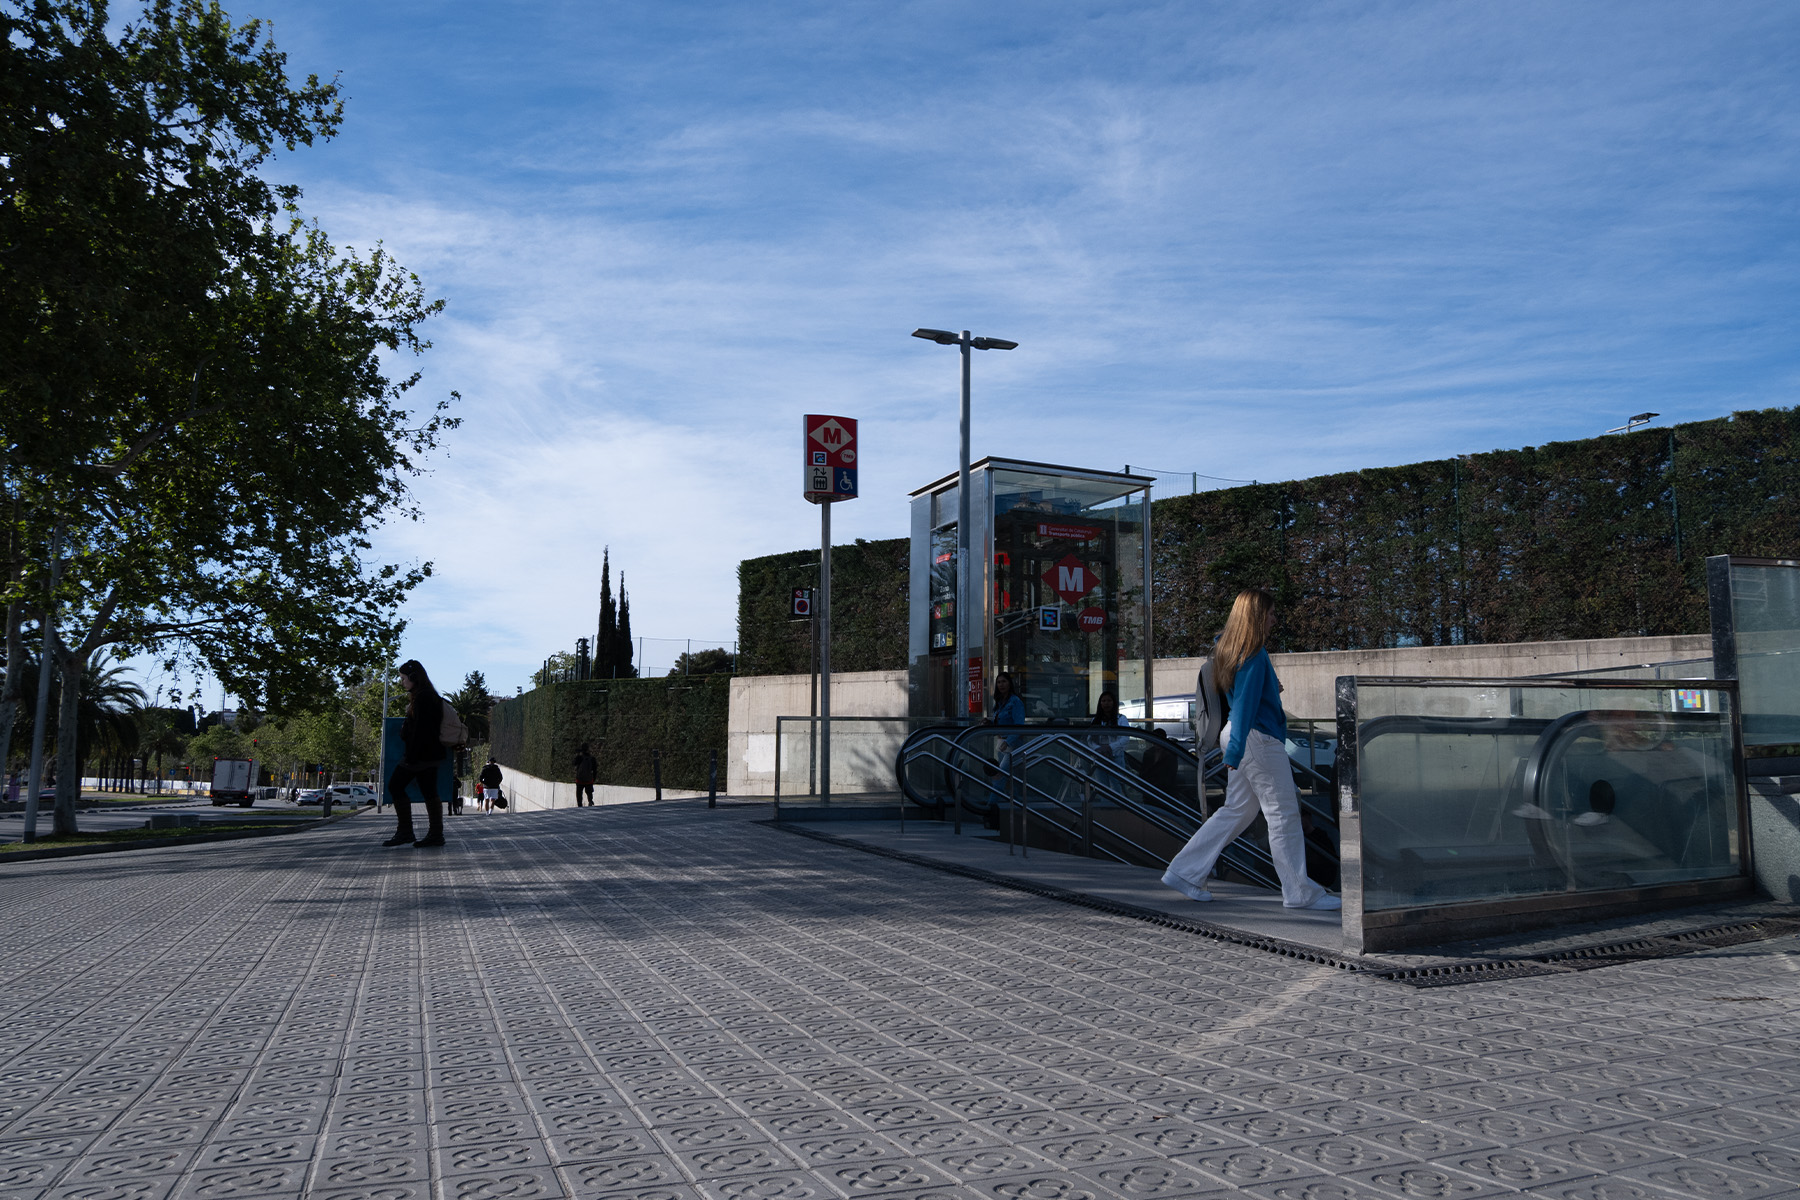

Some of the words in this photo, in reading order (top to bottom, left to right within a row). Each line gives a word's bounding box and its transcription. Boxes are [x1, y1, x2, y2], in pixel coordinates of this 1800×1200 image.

[824, 427, 841, 445] M
[1058, 565, 1084, 593] M
[1083, 616, 1104, 625] TMB
